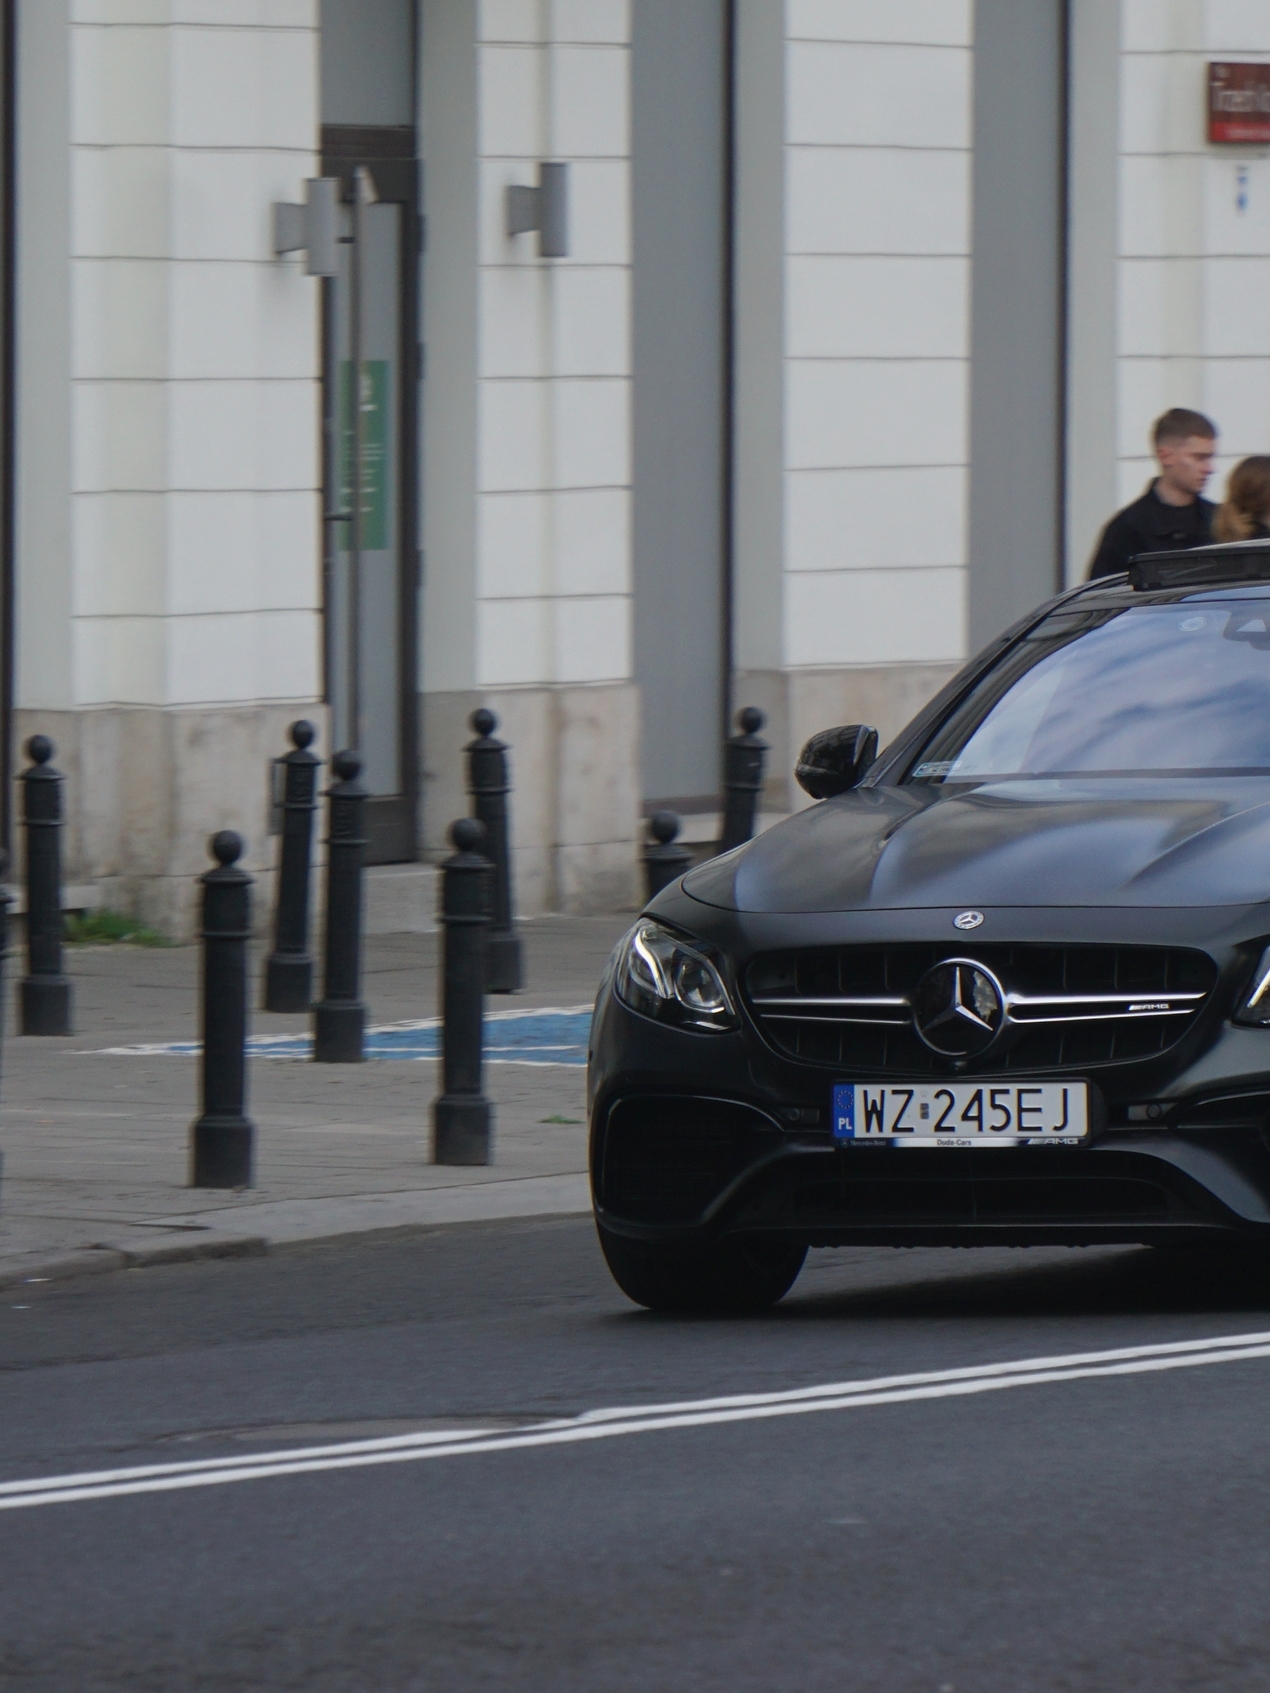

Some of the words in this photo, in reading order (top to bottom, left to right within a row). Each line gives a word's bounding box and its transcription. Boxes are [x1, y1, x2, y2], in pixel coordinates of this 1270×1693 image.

[862, 1089, 915, 1133] WZ
[933, 1088, 1069, 1133] 245EJ
[838, 1117, 853, 1130] PL
[936, 1138, 972, 1147] Duda-Cars
[1043, 1137, 1079, 1145] AMG
